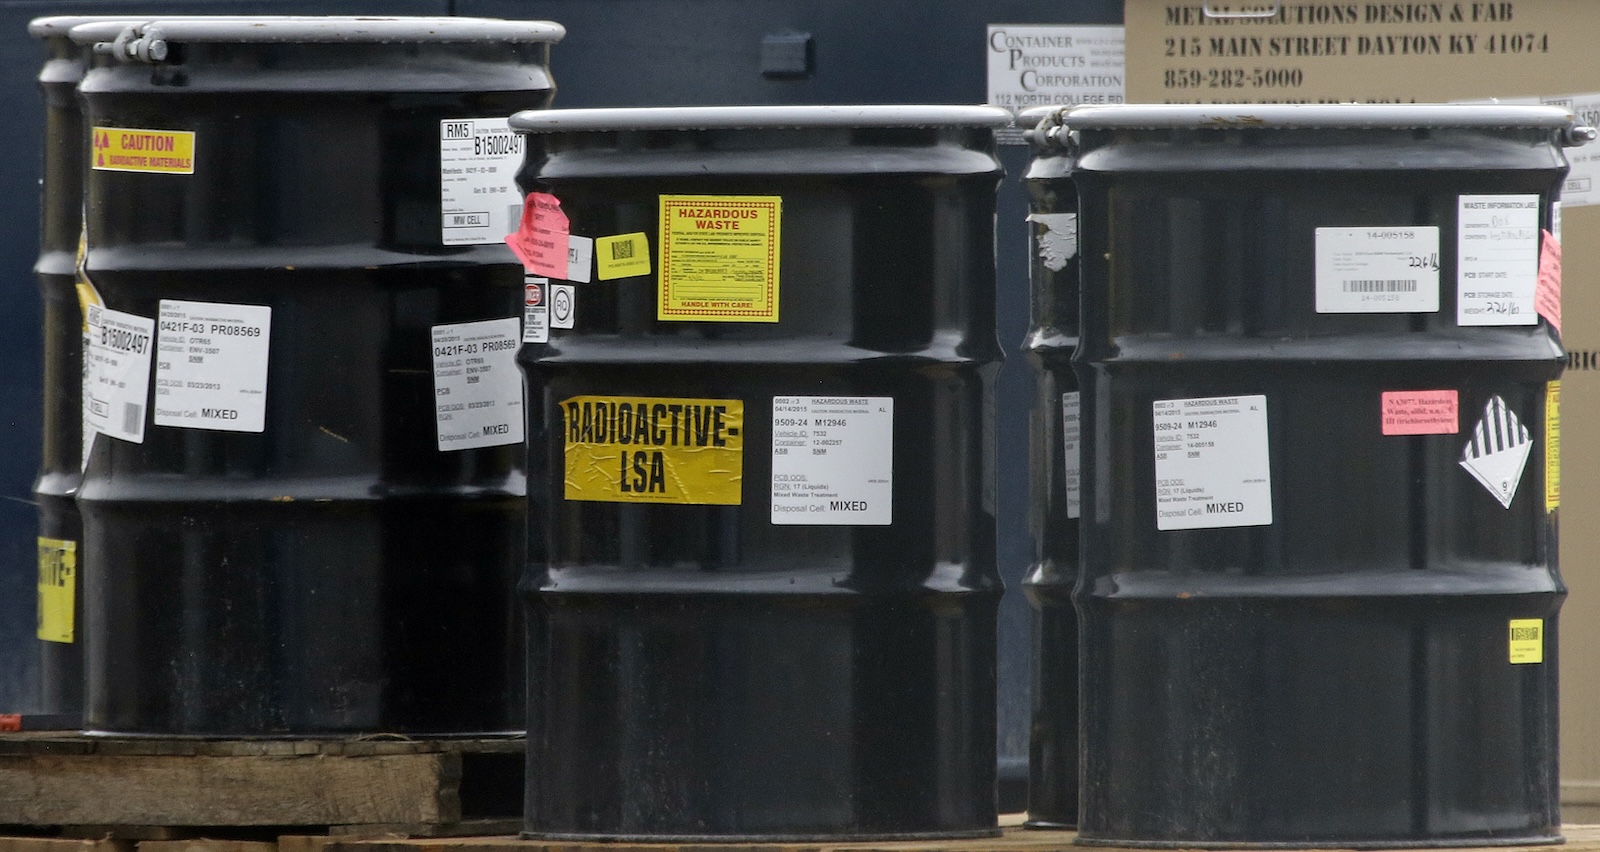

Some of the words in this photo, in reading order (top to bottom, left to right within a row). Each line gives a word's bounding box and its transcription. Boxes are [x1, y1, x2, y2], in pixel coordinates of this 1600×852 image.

[1165, 5, 1235, 27] METAL
[1239, 4, 1358, 26] SOLUTIONS
[1365, 4, 1443, 24] DESIGN
[1450, 4, 1465, 23] &
[1471, 3, 1513, 23] FAB
[990, 30, 1073, 53] CONTAINER
[1165, 36, 1202, 57] 215
[1209, 36, 1263, 57] MAIN
[1269, 36, 1351, 57] STREET
[1357, 34, 1442, 56] DAYTON
[1449, 33, 1479, 55] KY
[1484, 33, 1549, 54] 41074
[1009, 49, 1086, 71] PRODUCTS
[1020, 70, 1123, 93] CORPORATION
[1165, 68, 1304, 89] 859-282-5000
[995, 95, 1011, 105] 112
[1014, 95, 1051, 105] NORTH
[1054, 94, 1104, 105] COLLEGE
[1107, 94, 1124, 105] RD
[447, 123, 469, 138] RM5
[122, 134, 174, 152] CAUTION
[475, 135, 523, 155] B15002497
[150, 157, 192, 169] MATERIALS
[1464, 202, 1487, 210] WASTE
[1488, 202, 1524, 210] INFORMATION
[679, 208, 758, 219] HAZARDOUS
[454, 217, 466, 225] MW
[467, 216, 481, 225] CELL
[696, 220, 740, 230] WASTE
[1367, 231, 1415, 240] 14-005158
[1409, 256, 1427, 269] 226
[731, 302, 754, 310] CARE!
[160, 321, 205, 334] 0421F-03
[211, 325, 261, 338] PR08569
[102, 326, 150, 356] B15002497
[435, 344, 478, 358] 0421F-03
[482, 339, 517, 353] PR08569
[187, 382, 221, 390] 03/23/2013
[467, 376, 480, 384] SNM
[437, 388, 450, 396] PCB
[1184, 400, 1218, 408] HAZARDOUS
[156, 408, 182, 418] Disposal
[202, 408, 238, 421] MIXED
[568, 401, 739, 448] RADIOACTIVE-
[775, 419, 809, 427] 9509-24
[815, 419, 847, 427] M12946
[1155, 423, 1182, 431] 9509-24
[1188, 421, 1218, 429] M12946
[440, 432, 468, 443] Disposal
[483, 424, 510, 437] MIXED
[775, 430, 798, 438] Vehicle
[1156, 435, 1175, 443] Vehicle
[1157, 453, 1168, 461] ASB
[620, 450, 666, 493] LSA
[802, 483, 829, 492] (Liquids)
[1181, 487, 1205, 495] (Liquids)
[1503, 482, 1510, 492] 9
[774, 505, 808, 514] Disposal
[809, 505, 826, 513] Cell:
[830, 501, 868, 512] MIXED
[1159, 510, 1188, 520] Disposal
[1188, 509, 1203, 517] Cell:
[1206, 502, 1244, 514] MIXED
